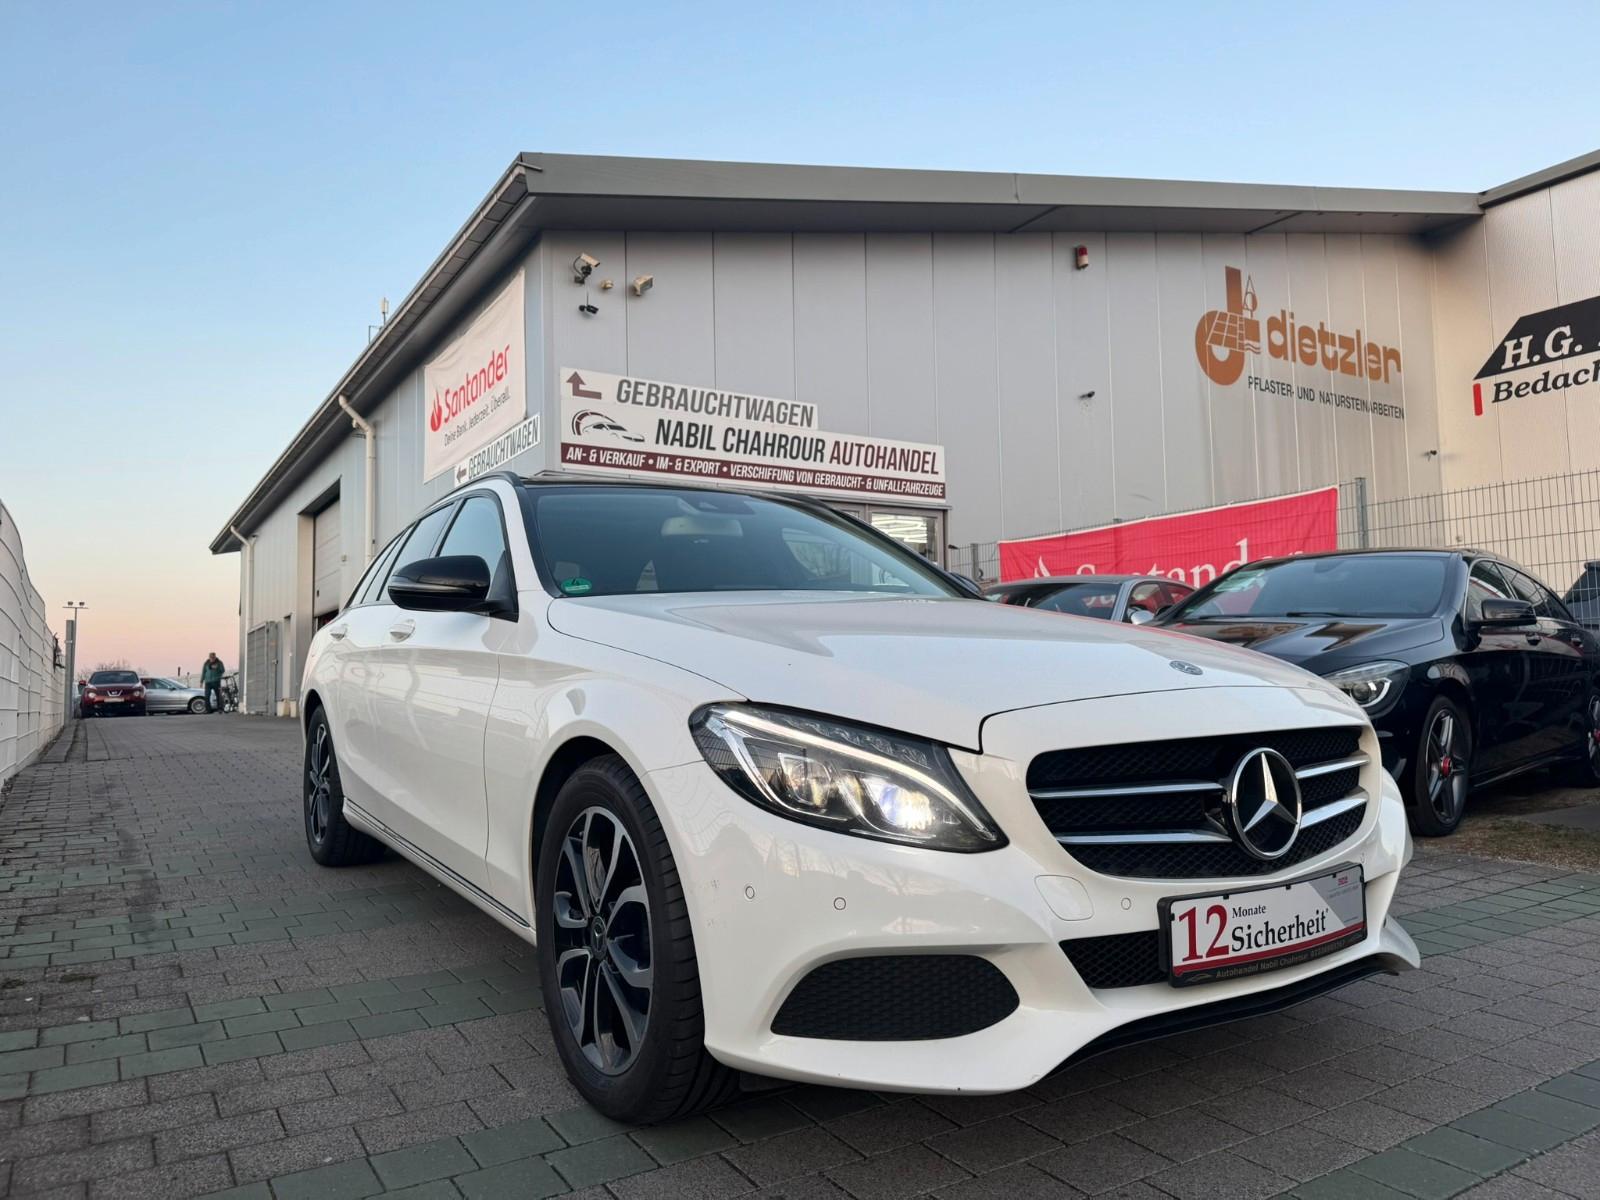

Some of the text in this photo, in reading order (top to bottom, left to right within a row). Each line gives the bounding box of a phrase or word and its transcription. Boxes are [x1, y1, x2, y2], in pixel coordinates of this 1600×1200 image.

[1266, 309, 1402, 384] dietzler
[1501, 325, 1583, 370] H.G.
[444, 344, 510, 423] Santander
[617, 379, 814, 428] GEBRAUCHTWAGEN
[1248, 375, 1405, 420] PFLASTER- UND NATURSTEINARBEITEN
[468, 414, 539, 480] GEBRAUCHTWAGEN
[566, 446, 943, 496] AN- & VERKAUF IM- & EXPORT VERSCHIFFUNG VON GEBRAUCHT- & UNFALLFAHRZEUGE
[655, 418, 939, 475] NABIL CHAHROUR AUTOHANDEL
[1178, 904, 1267, 962] 12 Monate
